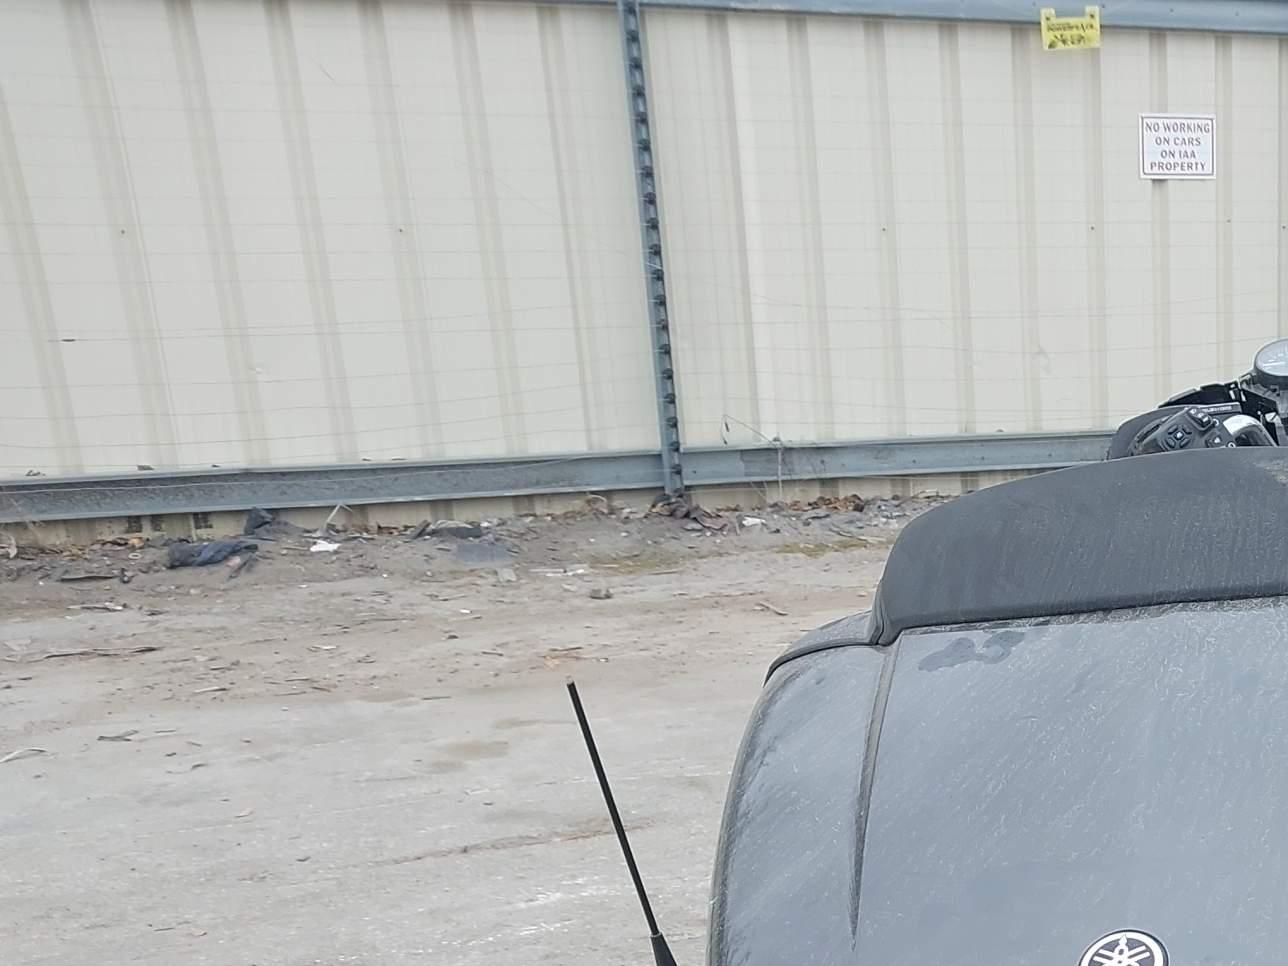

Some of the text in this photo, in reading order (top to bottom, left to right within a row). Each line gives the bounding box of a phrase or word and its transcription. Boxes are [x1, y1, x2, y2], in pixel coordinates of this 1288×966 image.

[1145, 121, 1210, 134] NO WORKING
[1155, 136, 1201, 147] ON CARS
[1160, 149, 1196, 159] ON IAA
[1150, 161, 1206, 172] PROPERTY
